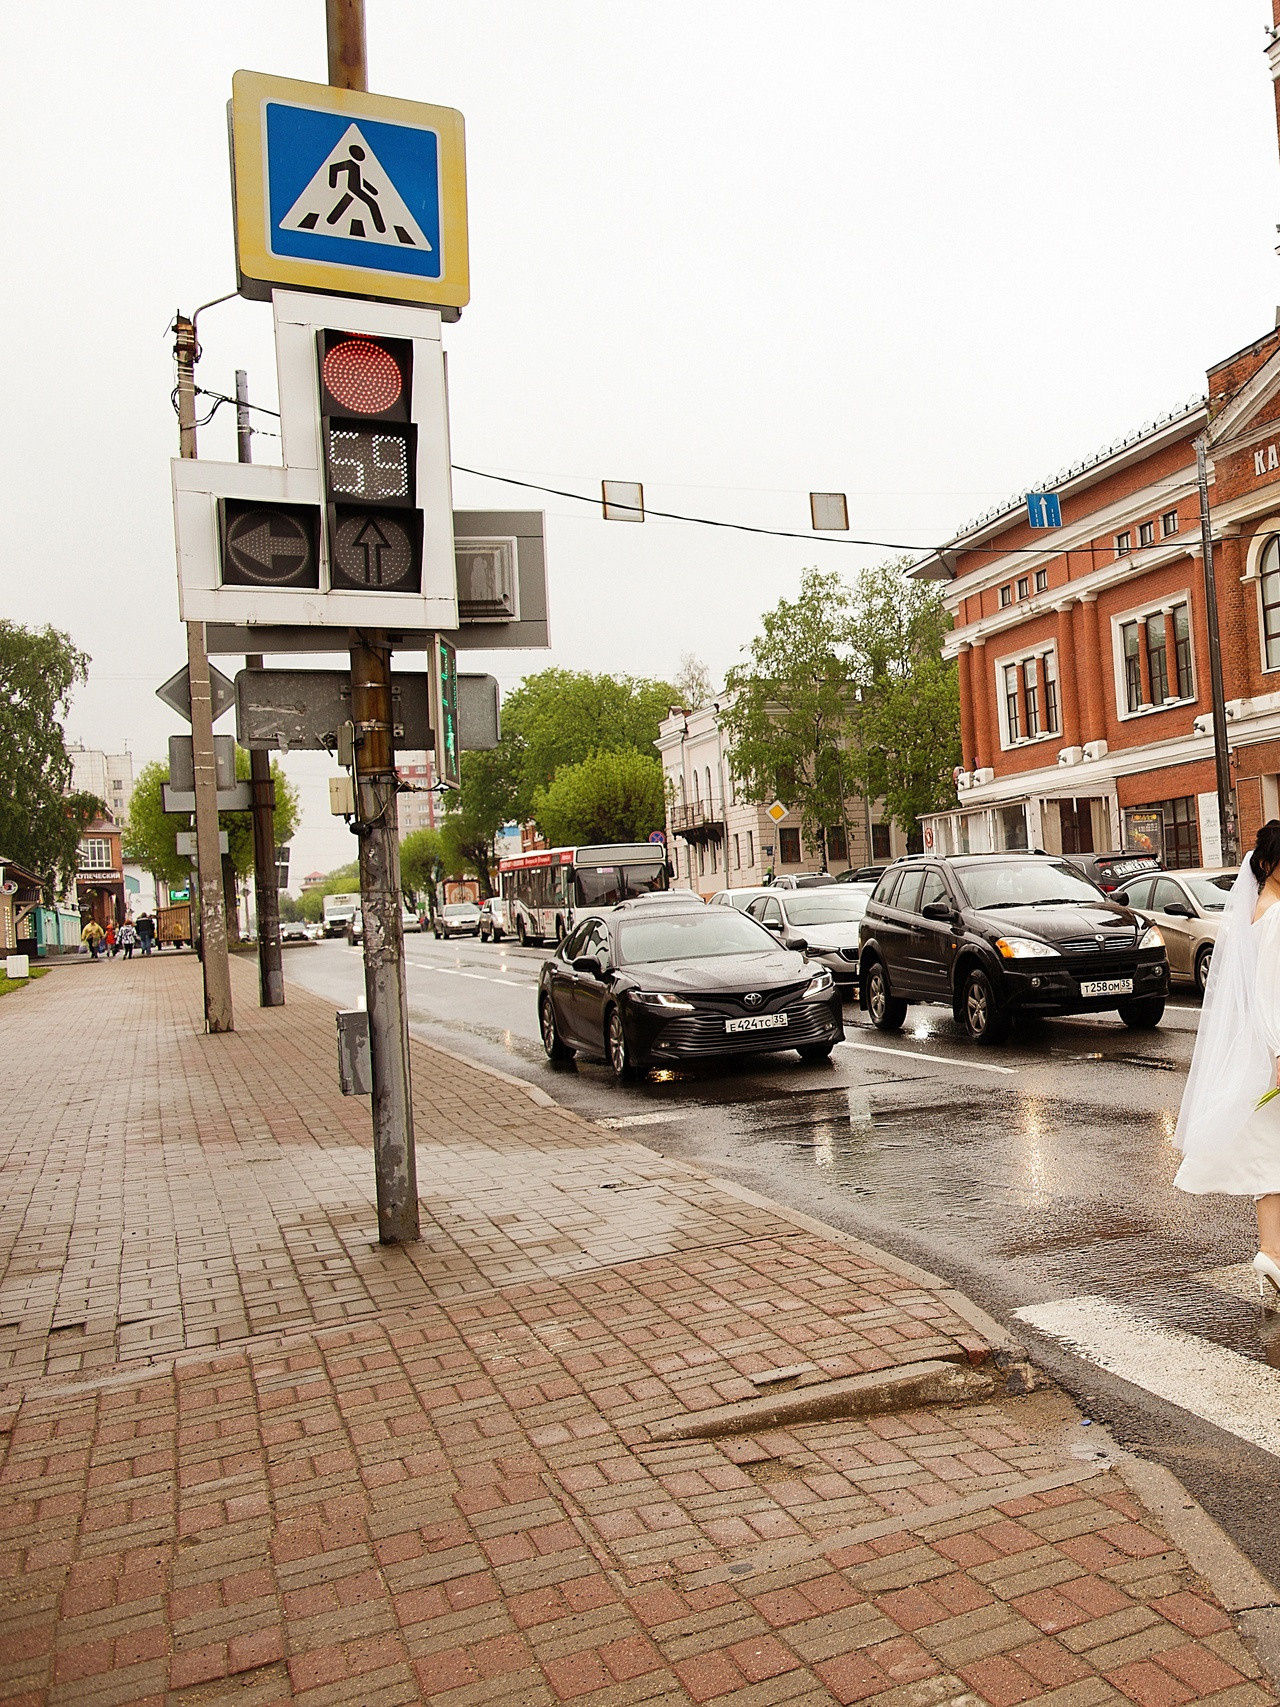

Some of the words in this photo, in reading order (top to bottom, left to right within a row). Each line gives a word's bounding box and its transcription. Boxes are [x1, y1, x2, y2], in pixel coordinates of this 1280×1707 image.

[329, 430, 409, 497] 59
[1084, 981, 1120, 993] Т258ОМ
[1121, 979, 1130, 987] 35
[729, 1018, 771, 1032] Е424ТС
[773, 1014, 784, 1024] 35
